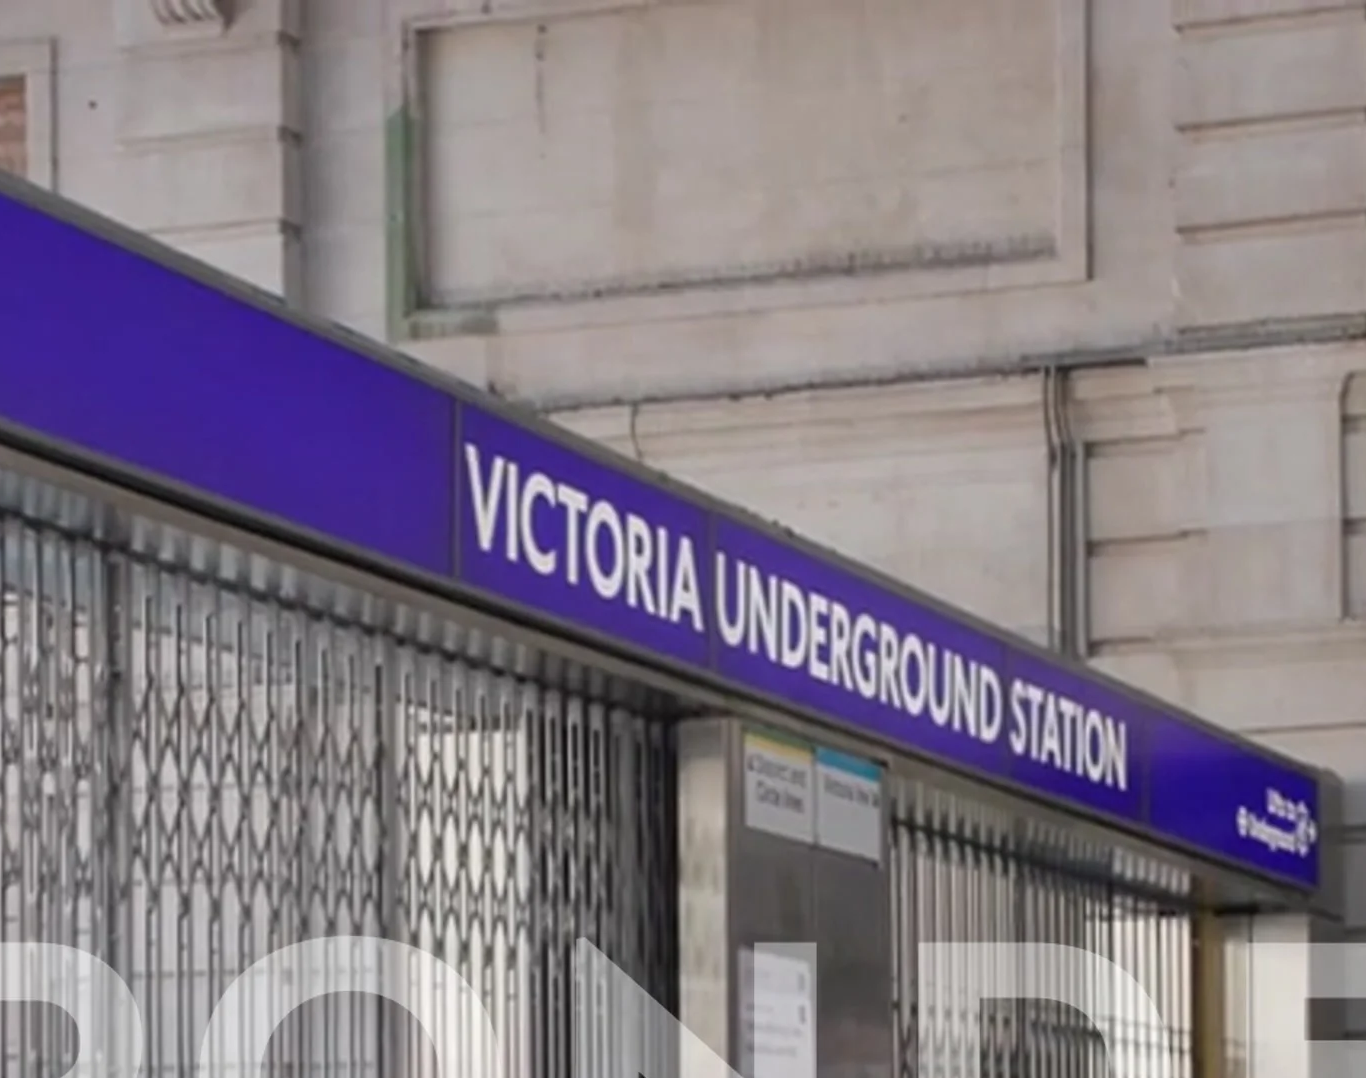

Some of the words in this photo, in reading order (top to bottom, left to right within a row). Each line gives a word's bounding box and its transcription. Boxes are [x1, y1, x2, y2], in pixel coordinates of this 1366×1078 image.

[464, 442, 704, 632] VICTORIA
[715, 551, 1002, 743] UNDERGROUND
[1008, 678, 1127, 791] STATION
